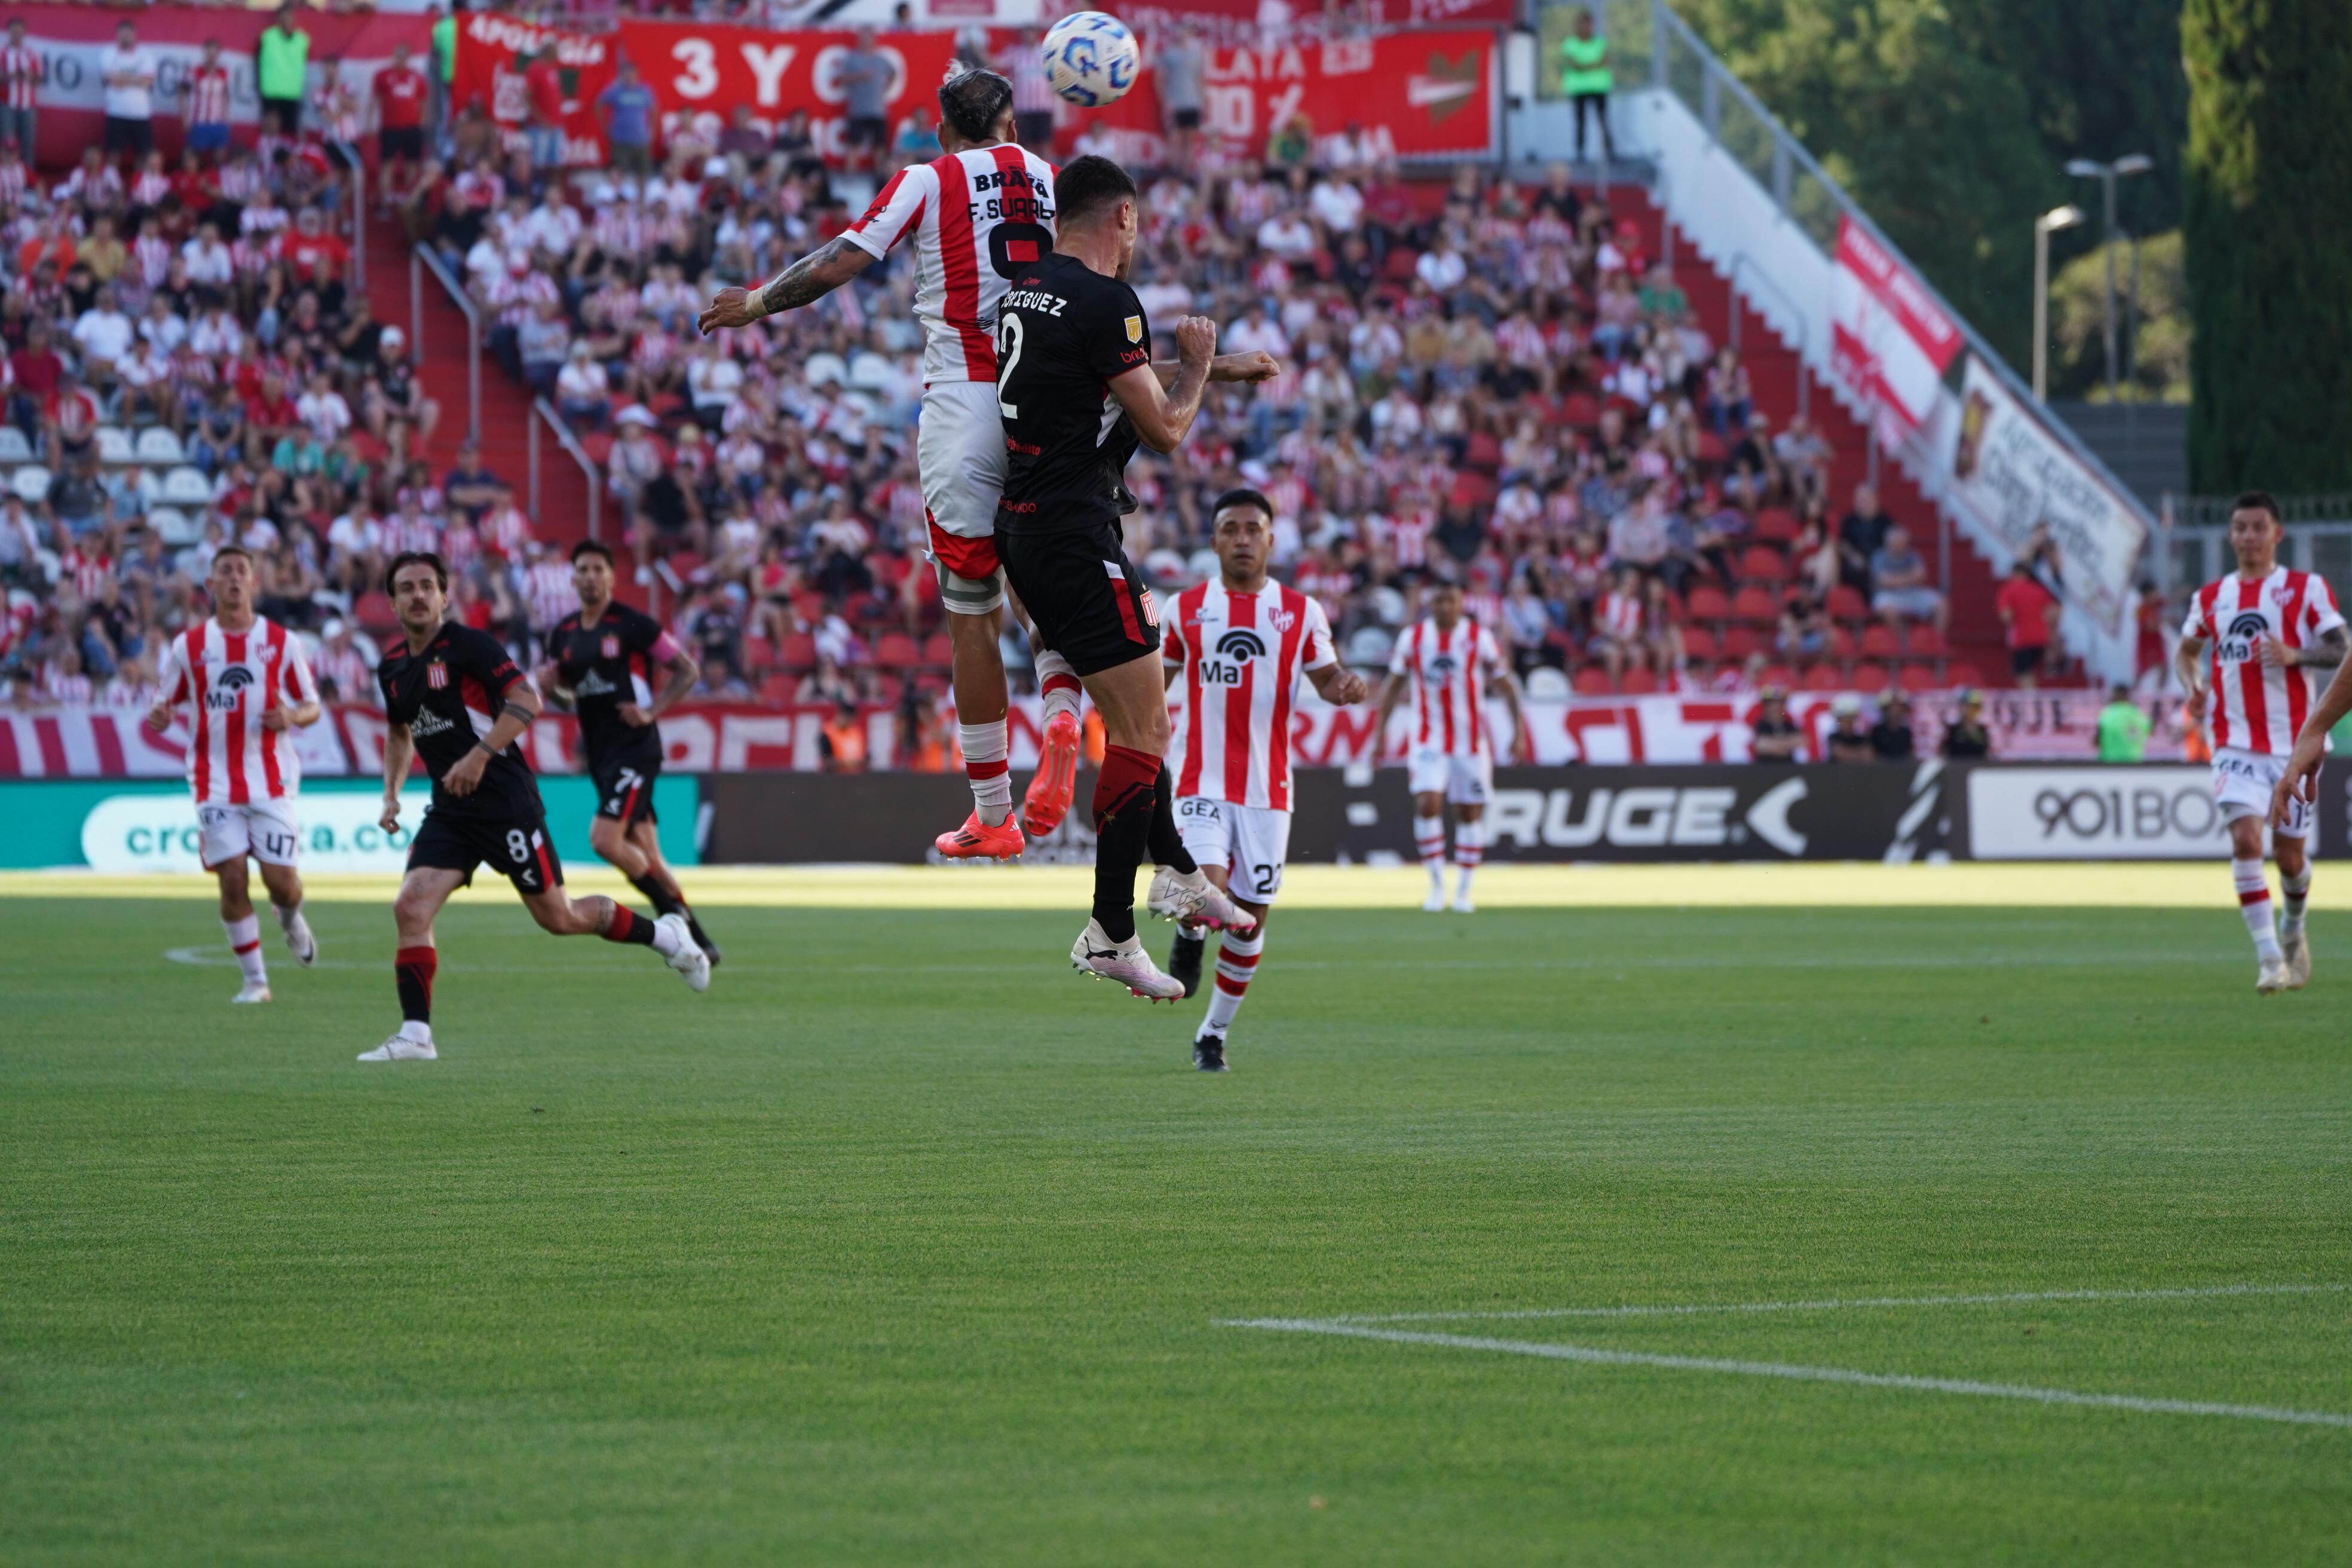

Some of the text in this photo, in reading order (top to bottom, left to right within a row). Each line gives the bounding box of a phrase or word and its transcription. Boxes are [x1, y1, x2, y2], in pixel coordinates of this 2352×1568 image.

[672, 38, 719, 99] 3
[740, 43, 797, 106] Y
[997, 312, 1024, 419] 2
[1201, 660, 1238, 684] Ma
[206, 692, 235, 709] Ma
[614, 766, 637, 794] 7
[1181, 801, 1221, 824] GEA
[267, 831, 295, 858] 47
[506, 828, 529, 863] 8
[1254, 863, 1282, 895] 2
